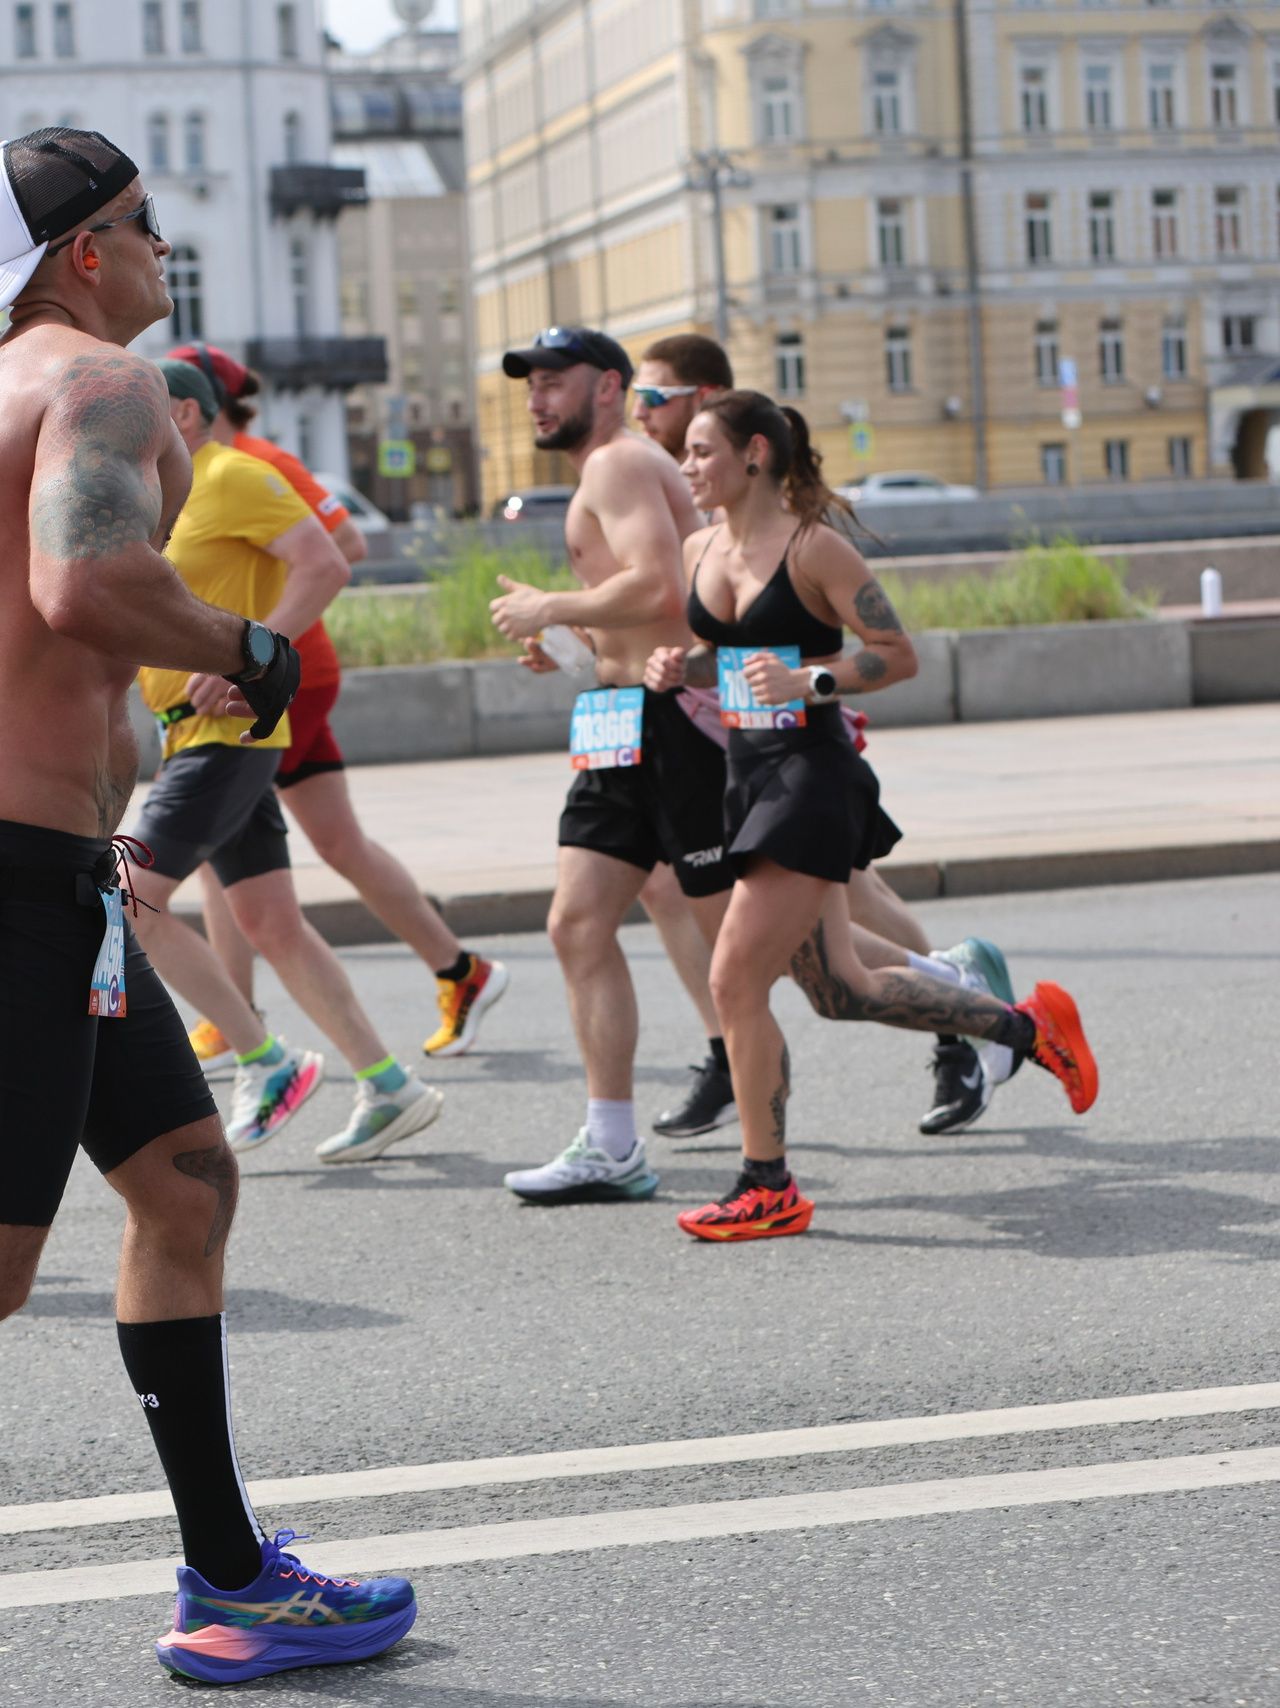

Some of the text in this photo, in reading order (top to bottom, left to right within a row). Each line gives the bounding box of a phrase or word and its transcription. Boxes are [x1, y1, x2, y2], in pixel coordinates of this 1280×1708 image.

[573, 709, 635, 752] 70366
[618, 747, 634, 767] C
[109, 980, 117, 1011] C
